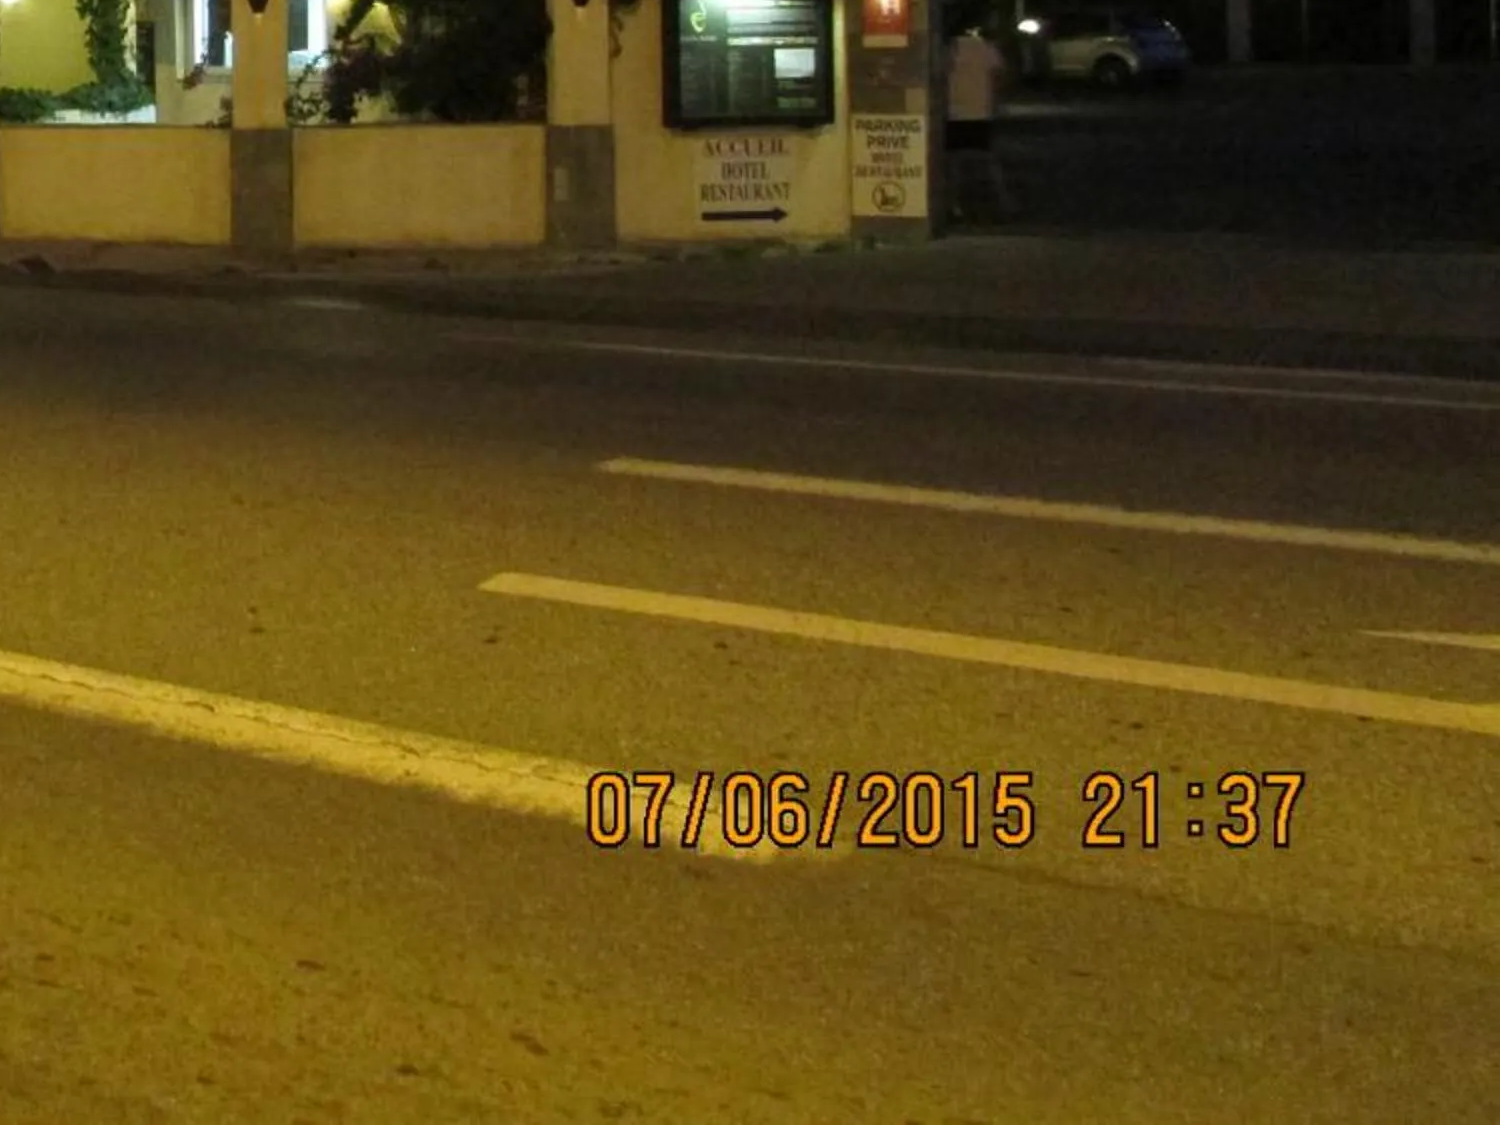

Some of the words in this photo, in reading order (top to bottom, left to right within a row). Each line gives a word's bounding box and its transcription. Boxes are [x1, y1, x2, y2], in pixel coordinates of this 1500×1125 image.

[703, 138, 789, 156] ACCUEIL
[721, 161, 770, 180] HOTEL
[701, 182, 790, 202] RESTAURANT
